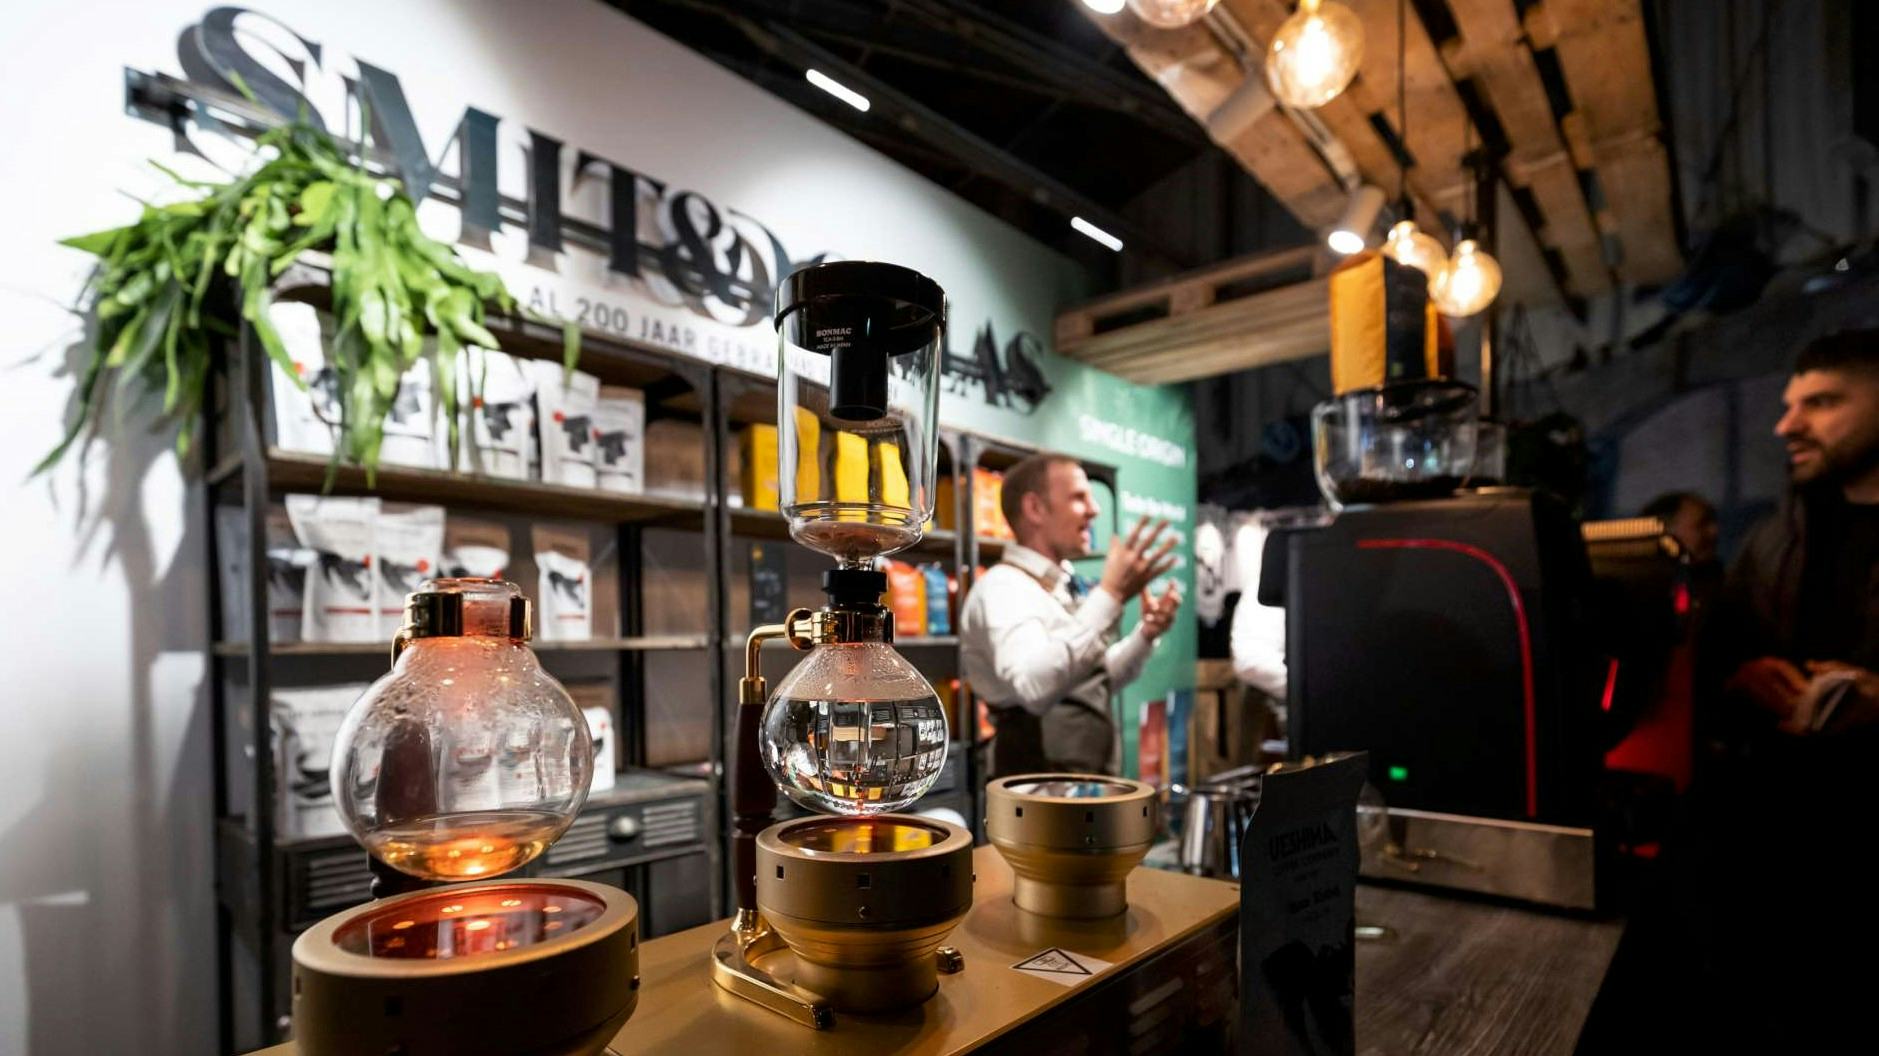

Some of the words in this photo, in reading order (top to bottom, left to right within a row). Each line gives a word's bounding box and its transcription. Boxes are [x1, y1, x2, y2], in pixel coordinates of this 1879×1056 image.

[529, 285, 558, 315] AL
[573, 297, 631, 333] 200
[639, 316, 697, 349] JAAR
[816, 327, 853, 337] BONMAC
